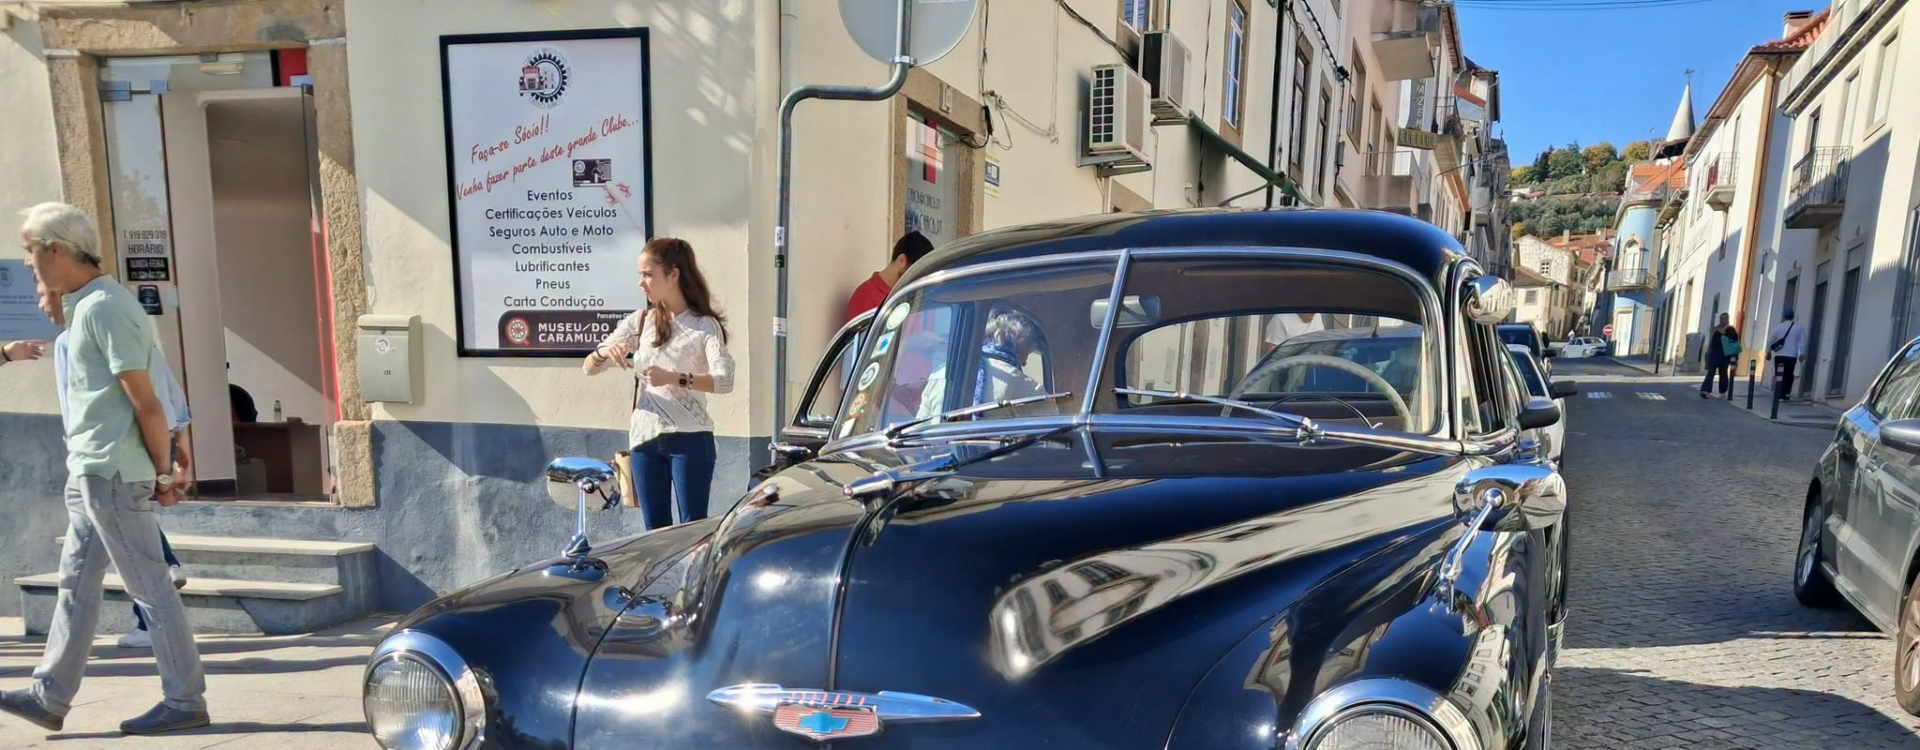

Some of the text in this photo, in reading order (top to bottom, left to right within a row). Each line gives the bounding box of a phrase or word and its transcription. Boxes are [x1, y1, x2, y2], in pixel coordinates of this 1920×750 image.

[471, 113, 550, 164] Faça-se Sócio!!
[456, 115, 639, 200] Venha fazer parte deste grande Clube...
[527, 189, 573, 201] Eventos
[485, 205, 617, 221] Certificações Veículos
[489, 224, 614, 240] Seguros Auto e Moto
[511, 242, 593, 255] Combustíveis
[515, 260, 591, 272] Lubrificantes
[535, 278, 571, 290] Pneus
[503, 295, 605, 309] Carta Condução
[538, 332, 609, 343] CARAMULO
